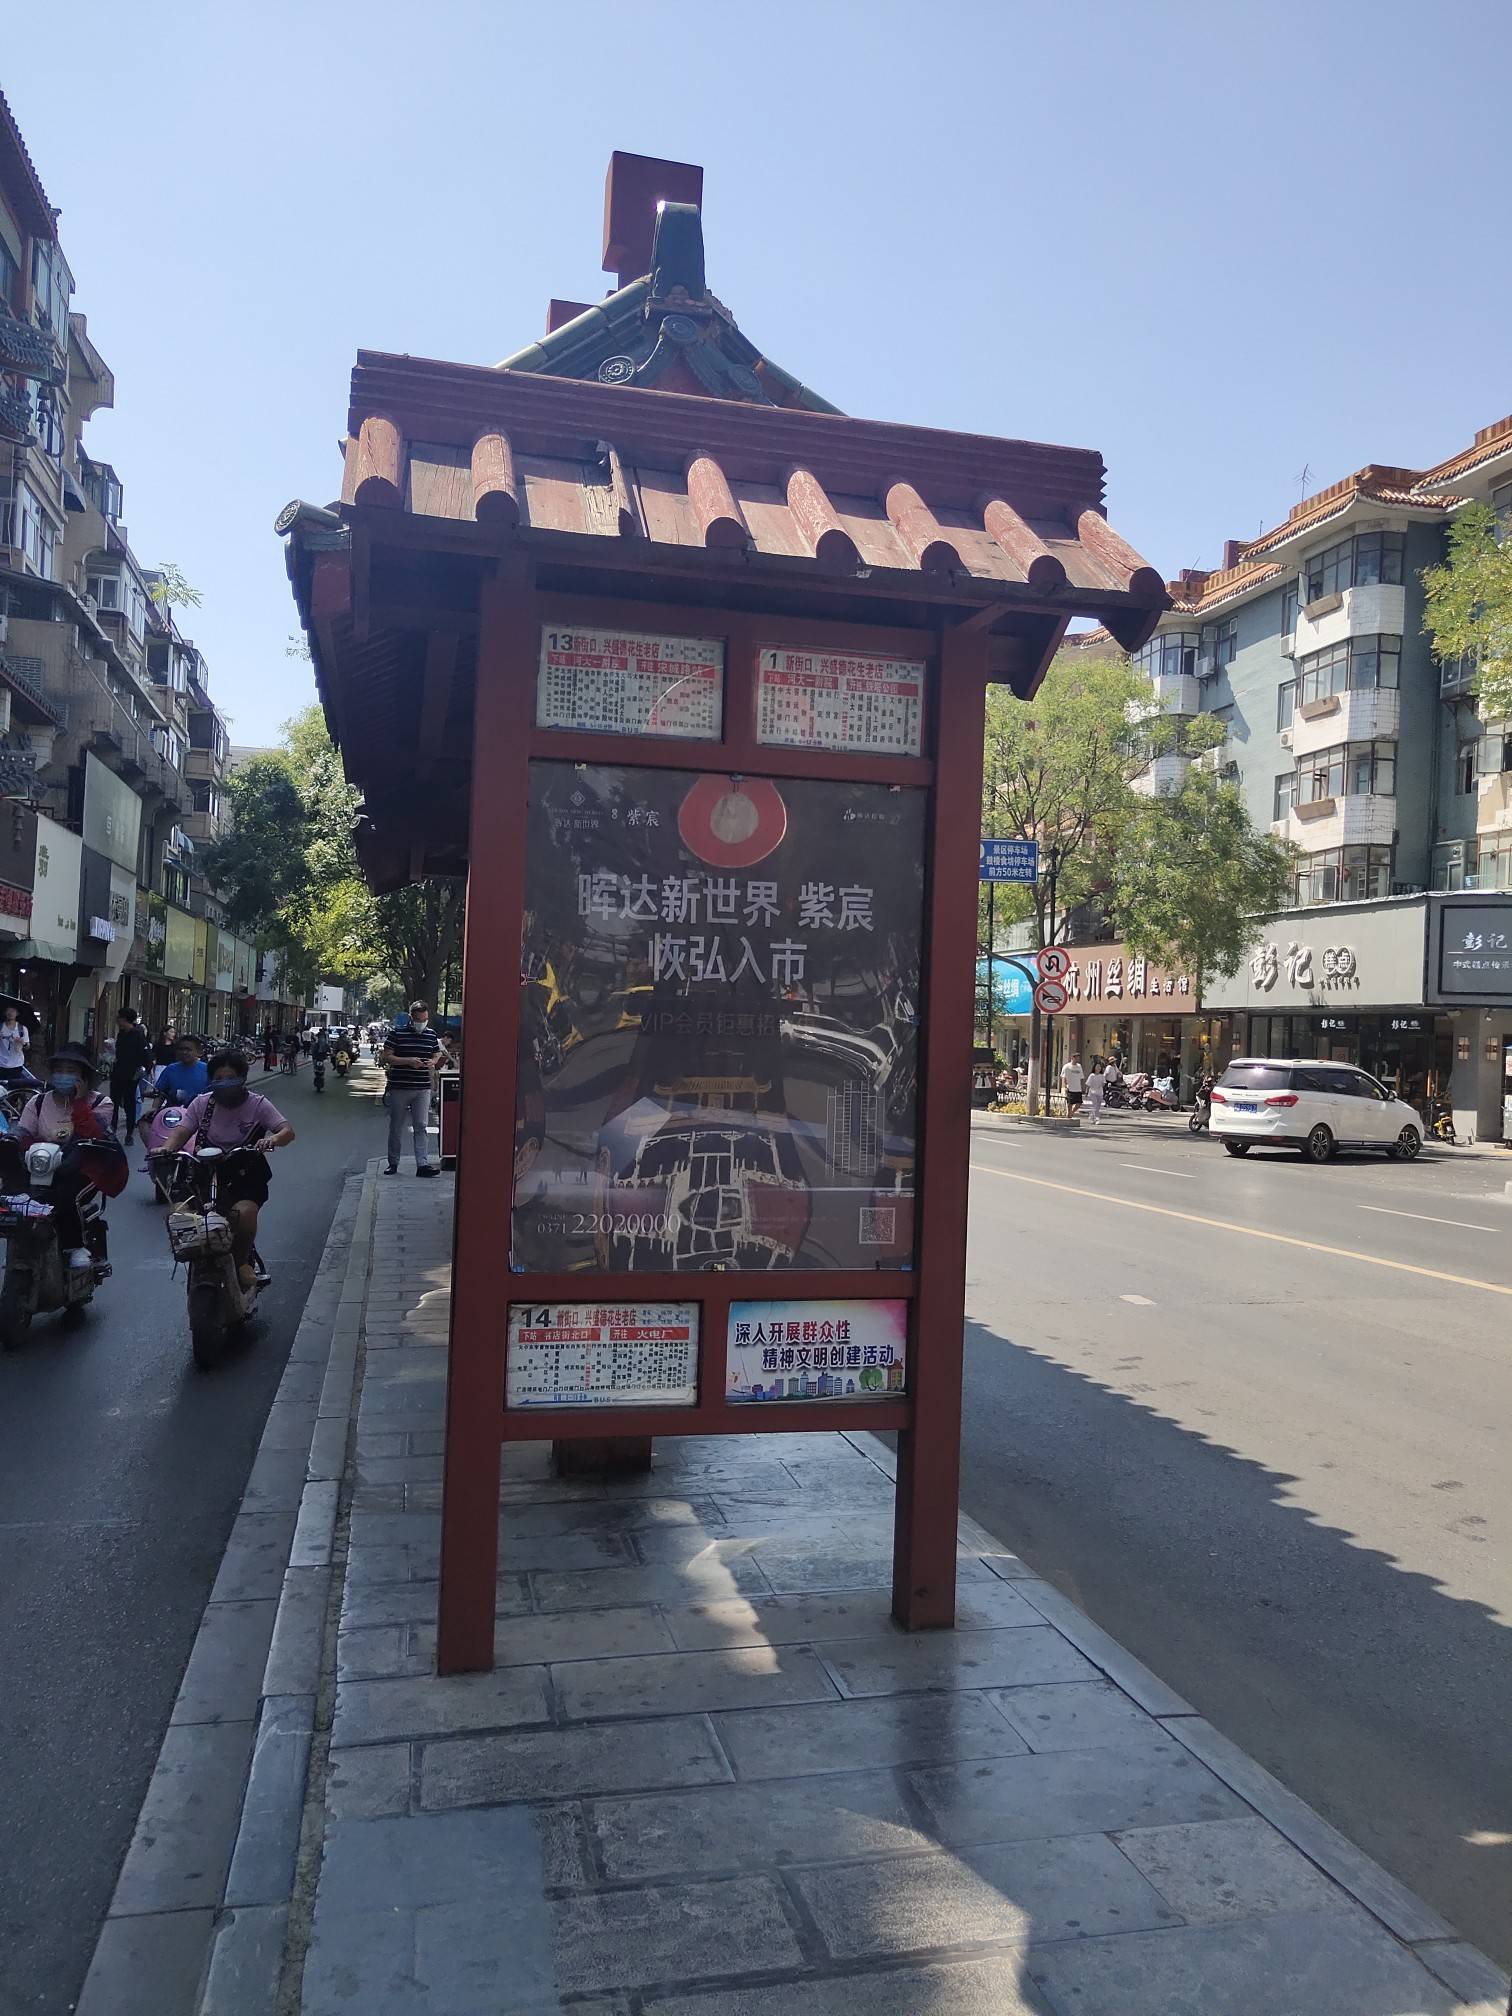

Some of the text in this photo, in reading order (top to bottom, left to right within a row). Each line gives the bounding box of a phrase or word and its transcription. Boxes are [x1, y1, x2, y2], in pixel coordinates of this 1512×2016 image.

[549, 633, 573, 651] 13
[769, 653, 777, 670] 1
[626, 808, 660, 827] 紫宸
[993, 844, 1028, 855] 景区停车场
[988, 867, 1033, 878] 前方50米左转
[578, 873, 875, 932] 晖达新世界 紫宸
[1462, 931, 1508, 951] 彭记
[648, 932, 808, 986] 恢弘入市
[1249, 943, 1314, 991] 彭记
[1453, 959, 1512, 970] 中式糕点传承
[537, 1223, 566, 1235] 0371
[571, 1213, 681, 1235] 22020000
[521, 1308, 552, 1328] 14
[637, 1329, 673, 1339] 火电厂
[735, 1320, 851, 1344] 深入开展群众性
[763, 1344, 894, 1369] 精神文明创建活动
